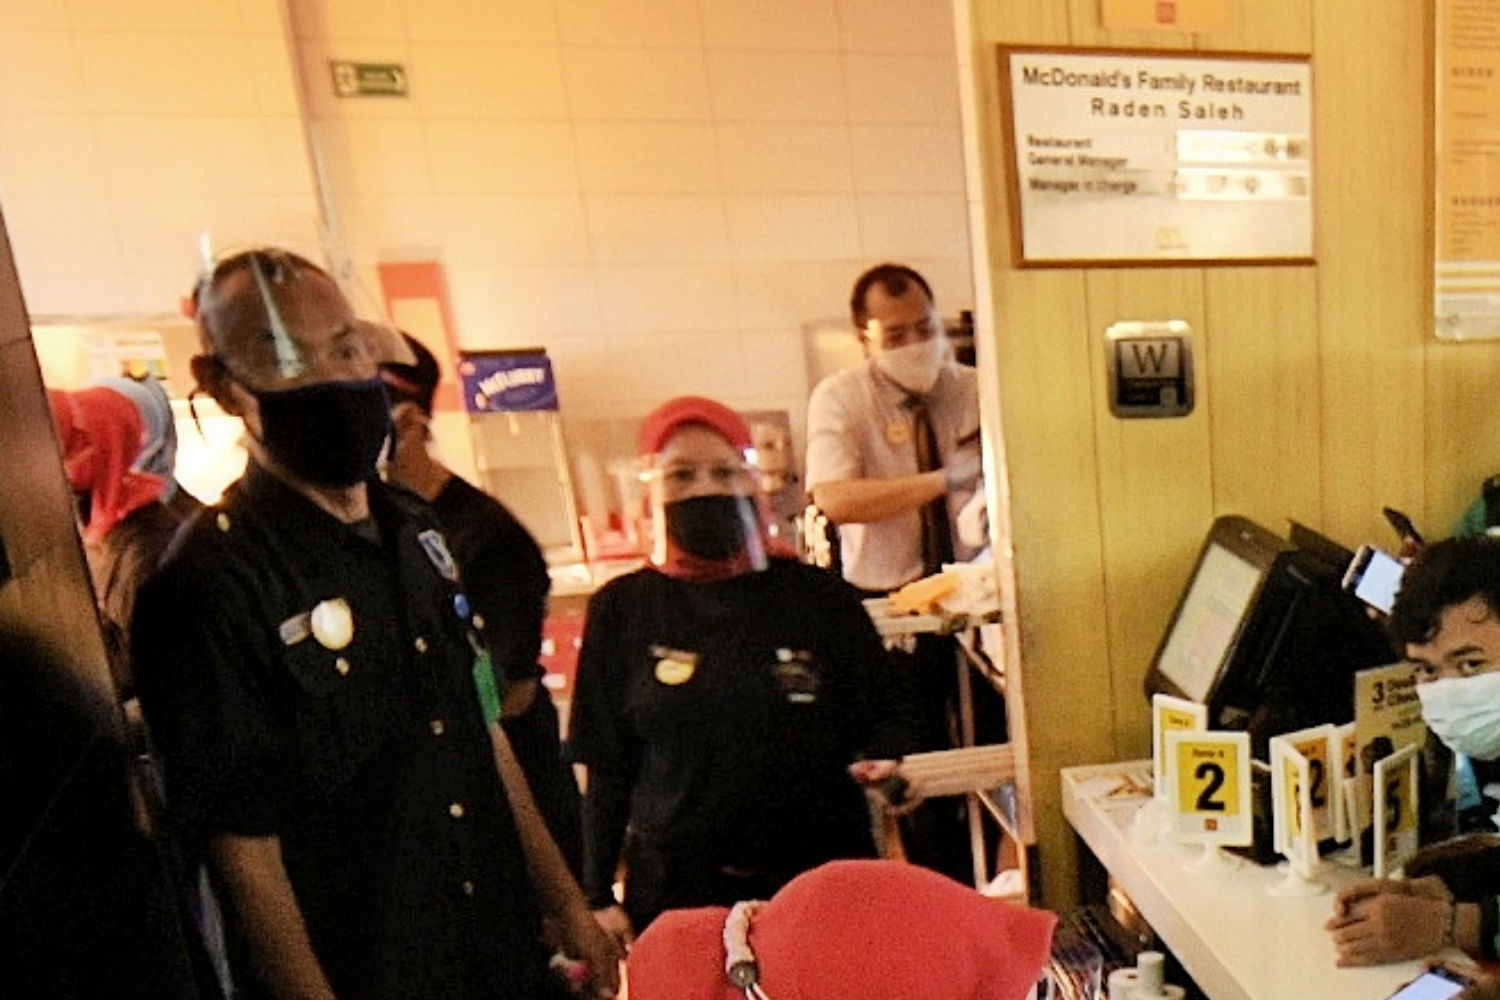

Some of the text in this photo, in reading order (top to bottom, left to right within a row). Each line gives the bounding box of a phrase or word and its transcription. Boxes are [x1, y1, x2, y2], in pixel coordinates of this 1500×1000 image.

[1022, 67, 1301, 96] McDonald's Family Restaurant
[1091, 97, 1244, 120] Raden Saleh
[1132, 343, 1168, 374] W
[1195, 762, 1225, 812] 2
